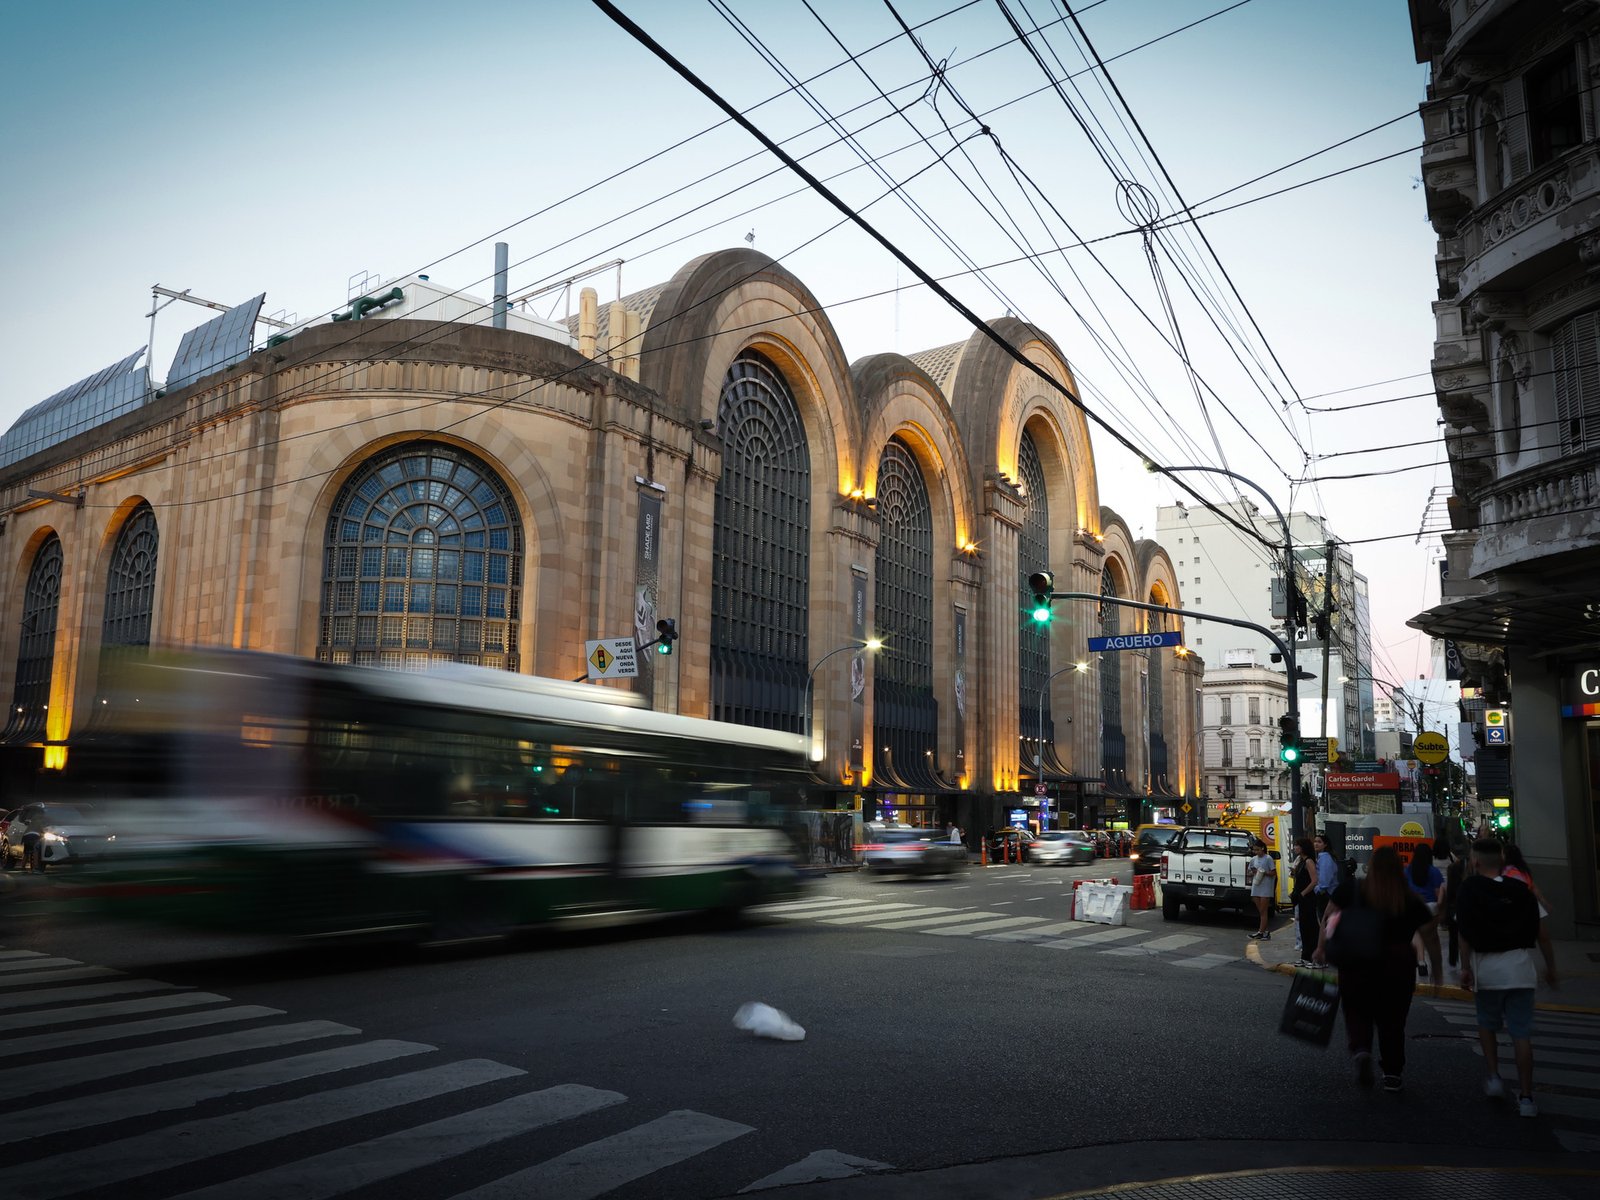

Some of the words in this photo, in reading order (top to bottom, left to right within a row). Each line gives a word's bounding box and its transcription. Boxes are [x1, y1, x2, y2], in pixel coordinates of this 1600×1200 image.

[1105, 634, 1163, 650] AGUERO
[1580, 669, 1600, 695] C
[1418, 742, 1444, 751] Subte
[1393, 842, 1415, 852] OBRA
[1174, 873, 1237, 884] RANGER
